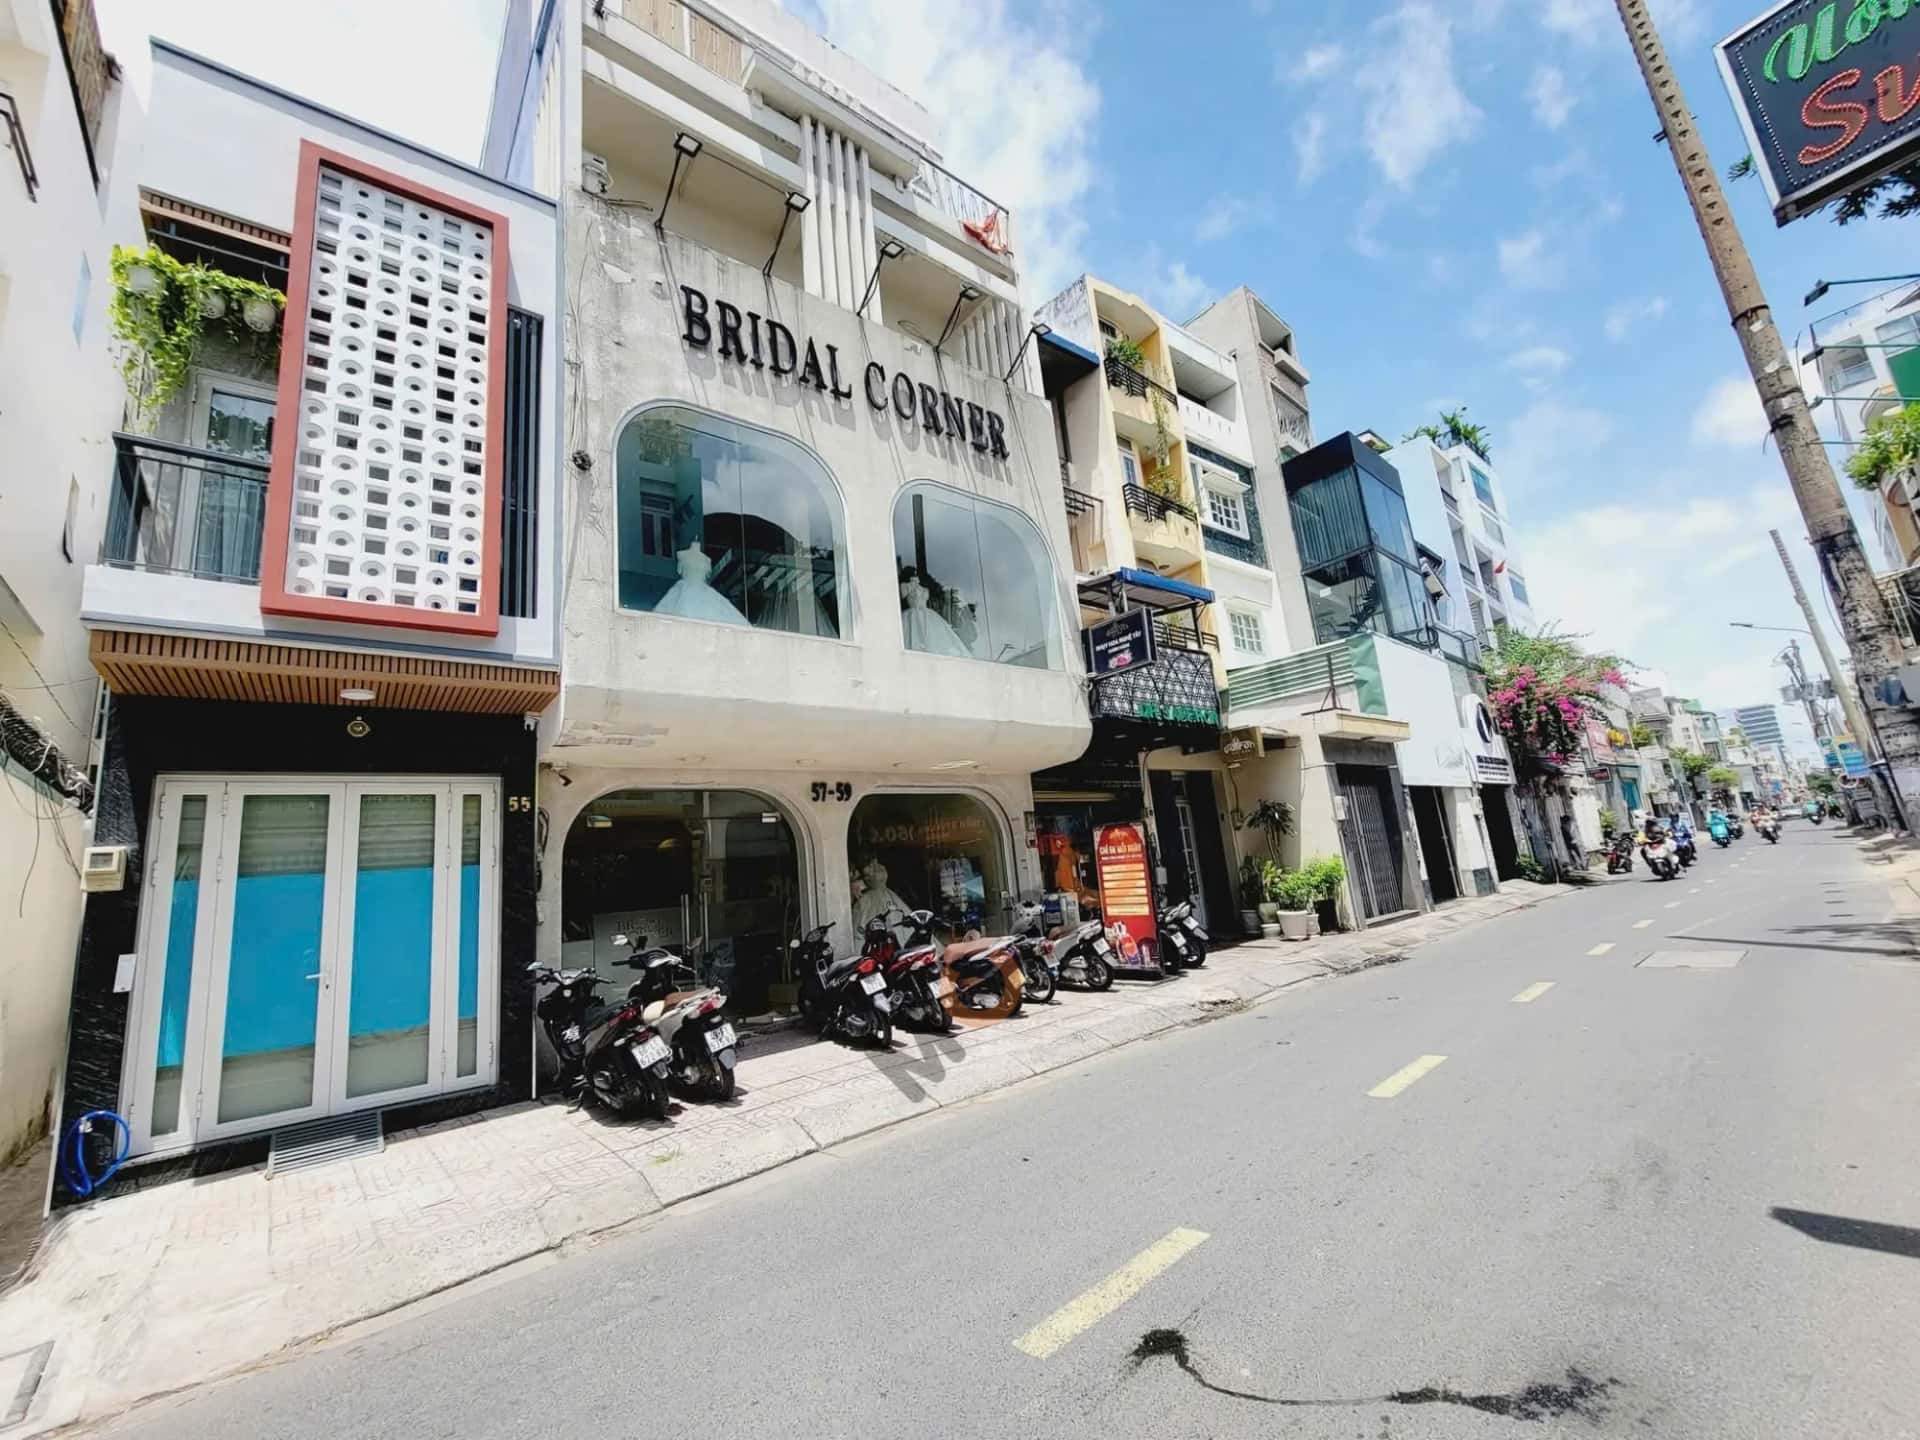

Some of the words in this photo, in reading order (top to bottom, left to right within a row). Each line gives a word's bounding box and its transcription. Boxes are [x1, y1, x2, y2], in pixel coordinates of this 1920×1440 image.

[680, 285, 852, 400] BRIDAL
[864, 361, 1010, 460] CORNER
[811, 781, 853, 802] 57-59
[508, 796, 531, 812] 55
